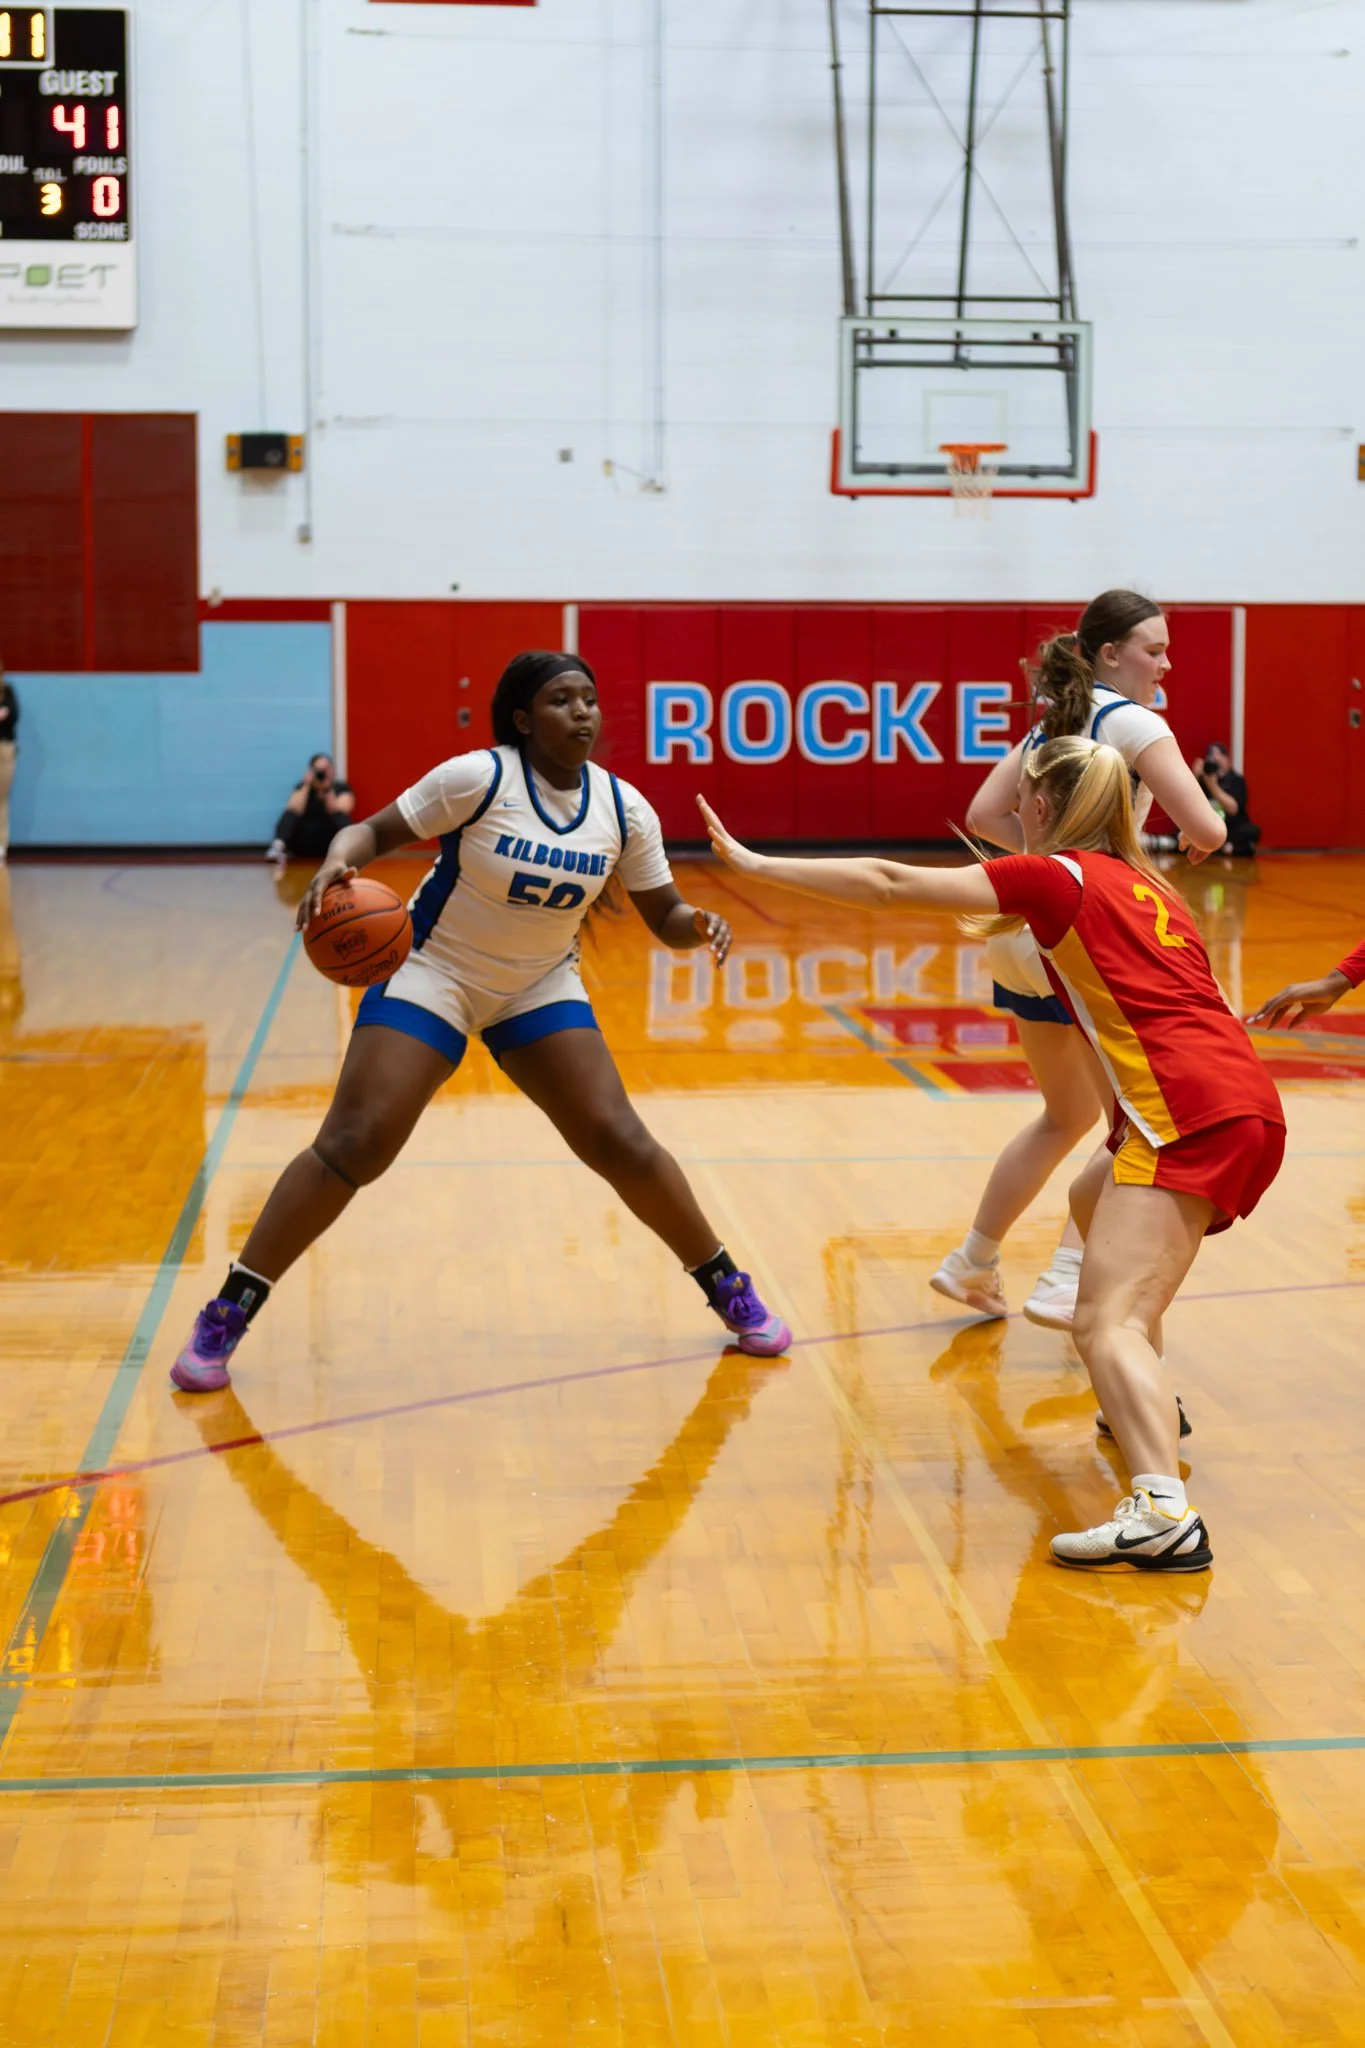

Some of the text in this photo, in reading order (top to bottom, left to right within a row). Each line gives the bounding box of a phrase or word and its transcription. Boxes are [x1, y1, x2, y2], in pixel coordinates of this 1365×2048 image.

[39, 70, 118, 96] GUEST
[52, 104, 119, 150] 41
[73, 156, 127, 175] FOULS
[40, 182, 62, 215] 3
[92, 176, 120, 217] 0
[73, 221, 128, 240] SCORE
[646, 681, 1168, 764] ROCKE
[494, 833, 608, 877] KILBOURNE
[506, 871, 586, 910] 50
[1132, 883, 1190, 948] 2
